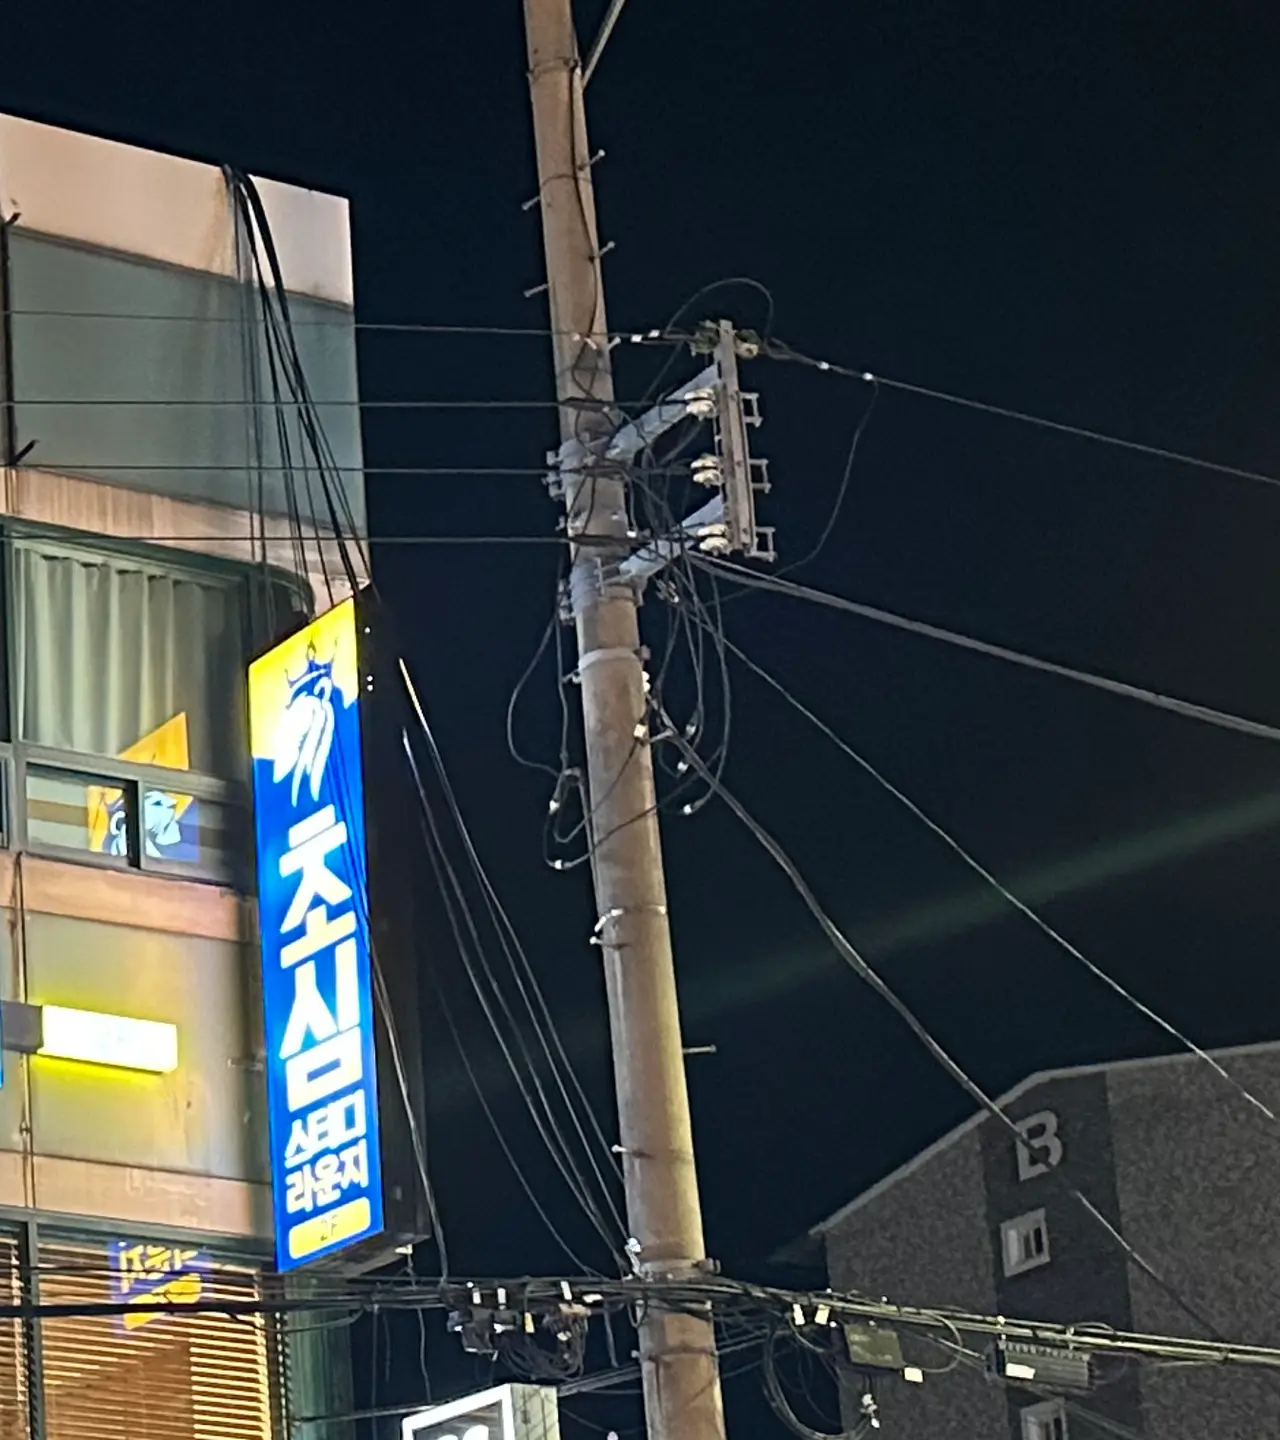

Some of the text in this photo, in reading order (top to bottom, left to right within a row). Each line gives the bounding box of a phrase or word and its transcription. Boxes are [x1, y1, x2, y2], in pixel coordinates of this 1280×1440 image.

[279, 804, 363, 1112] 초심
[284, 1098, 367, 1167] 스터디
[286, 1145, 371, 1214] 라운지
